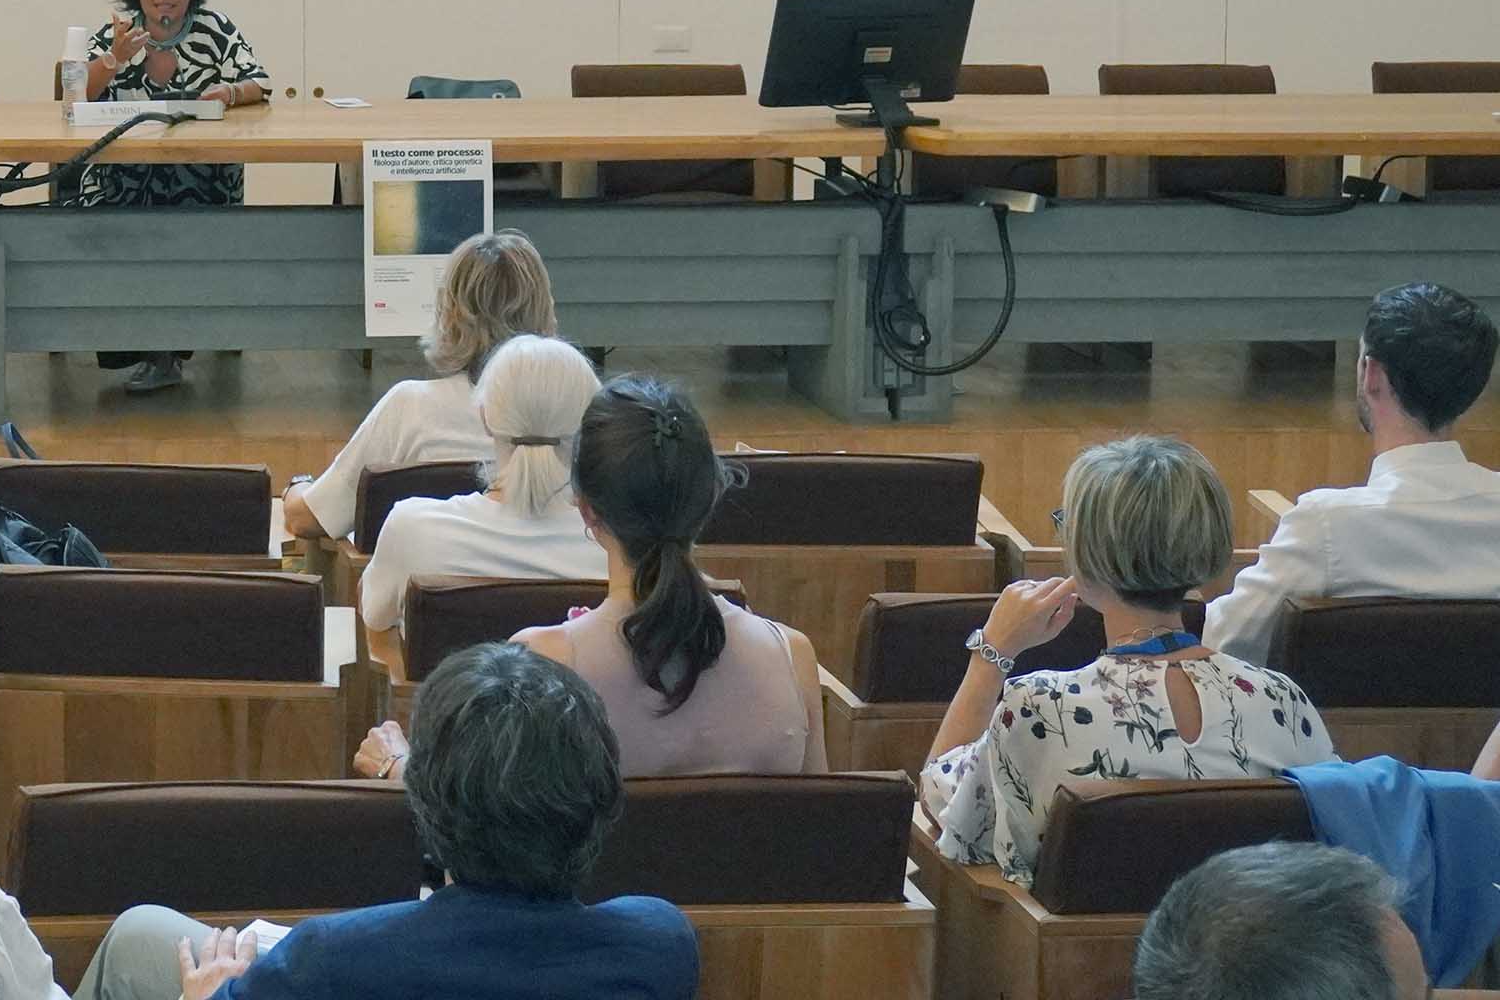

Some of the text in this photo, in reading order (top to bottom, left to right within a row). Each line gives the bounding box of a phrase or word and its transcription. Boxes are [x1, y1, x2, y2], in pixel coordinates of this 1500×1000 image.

[372, 149, 378, 157] Il
[381, 150, 405, 158] testo
[437, 149, 484, 158] processo:
[454, 158, 483, 166] genetica
[396, 167, 434, 176] intelligenza
